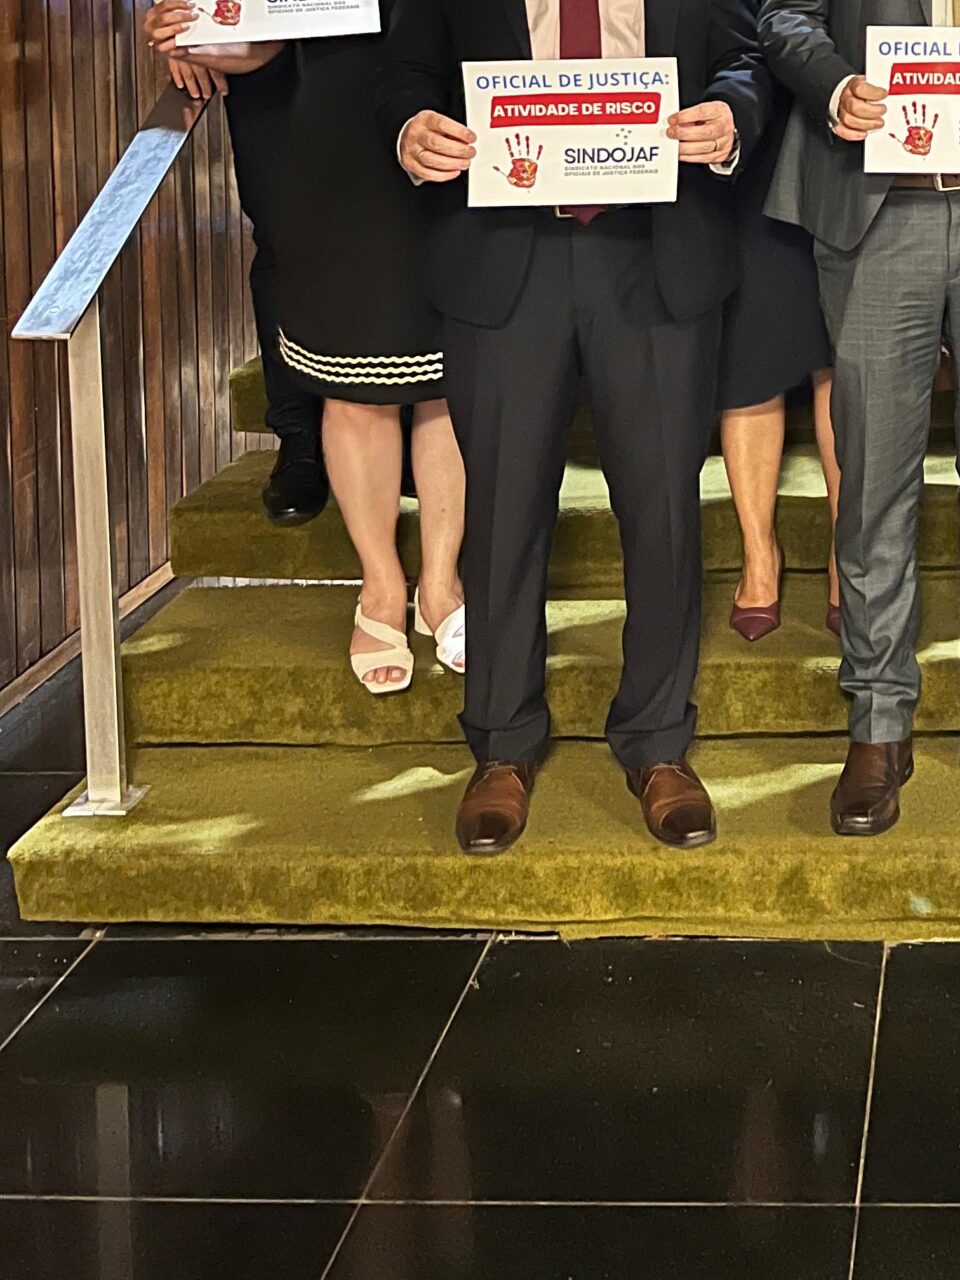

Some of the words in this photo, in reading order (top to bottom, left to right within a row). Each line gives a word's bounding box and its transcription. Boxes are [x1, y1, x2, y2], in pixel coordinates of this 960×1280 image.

[878, 41, 952, 56] OFICIAL
[476, 74, 552, 90] OFICIAL
[559, 73, 583, 88] DE
[587, 71, 670, 91] JUSTIÇA:
[493, 103, 579, 118] ATIVIDADE
[581, 102, 603, 116] DE
[605, 101, 656, 115] RISCO
[564, 146, 659, 164] SINDOJAF
